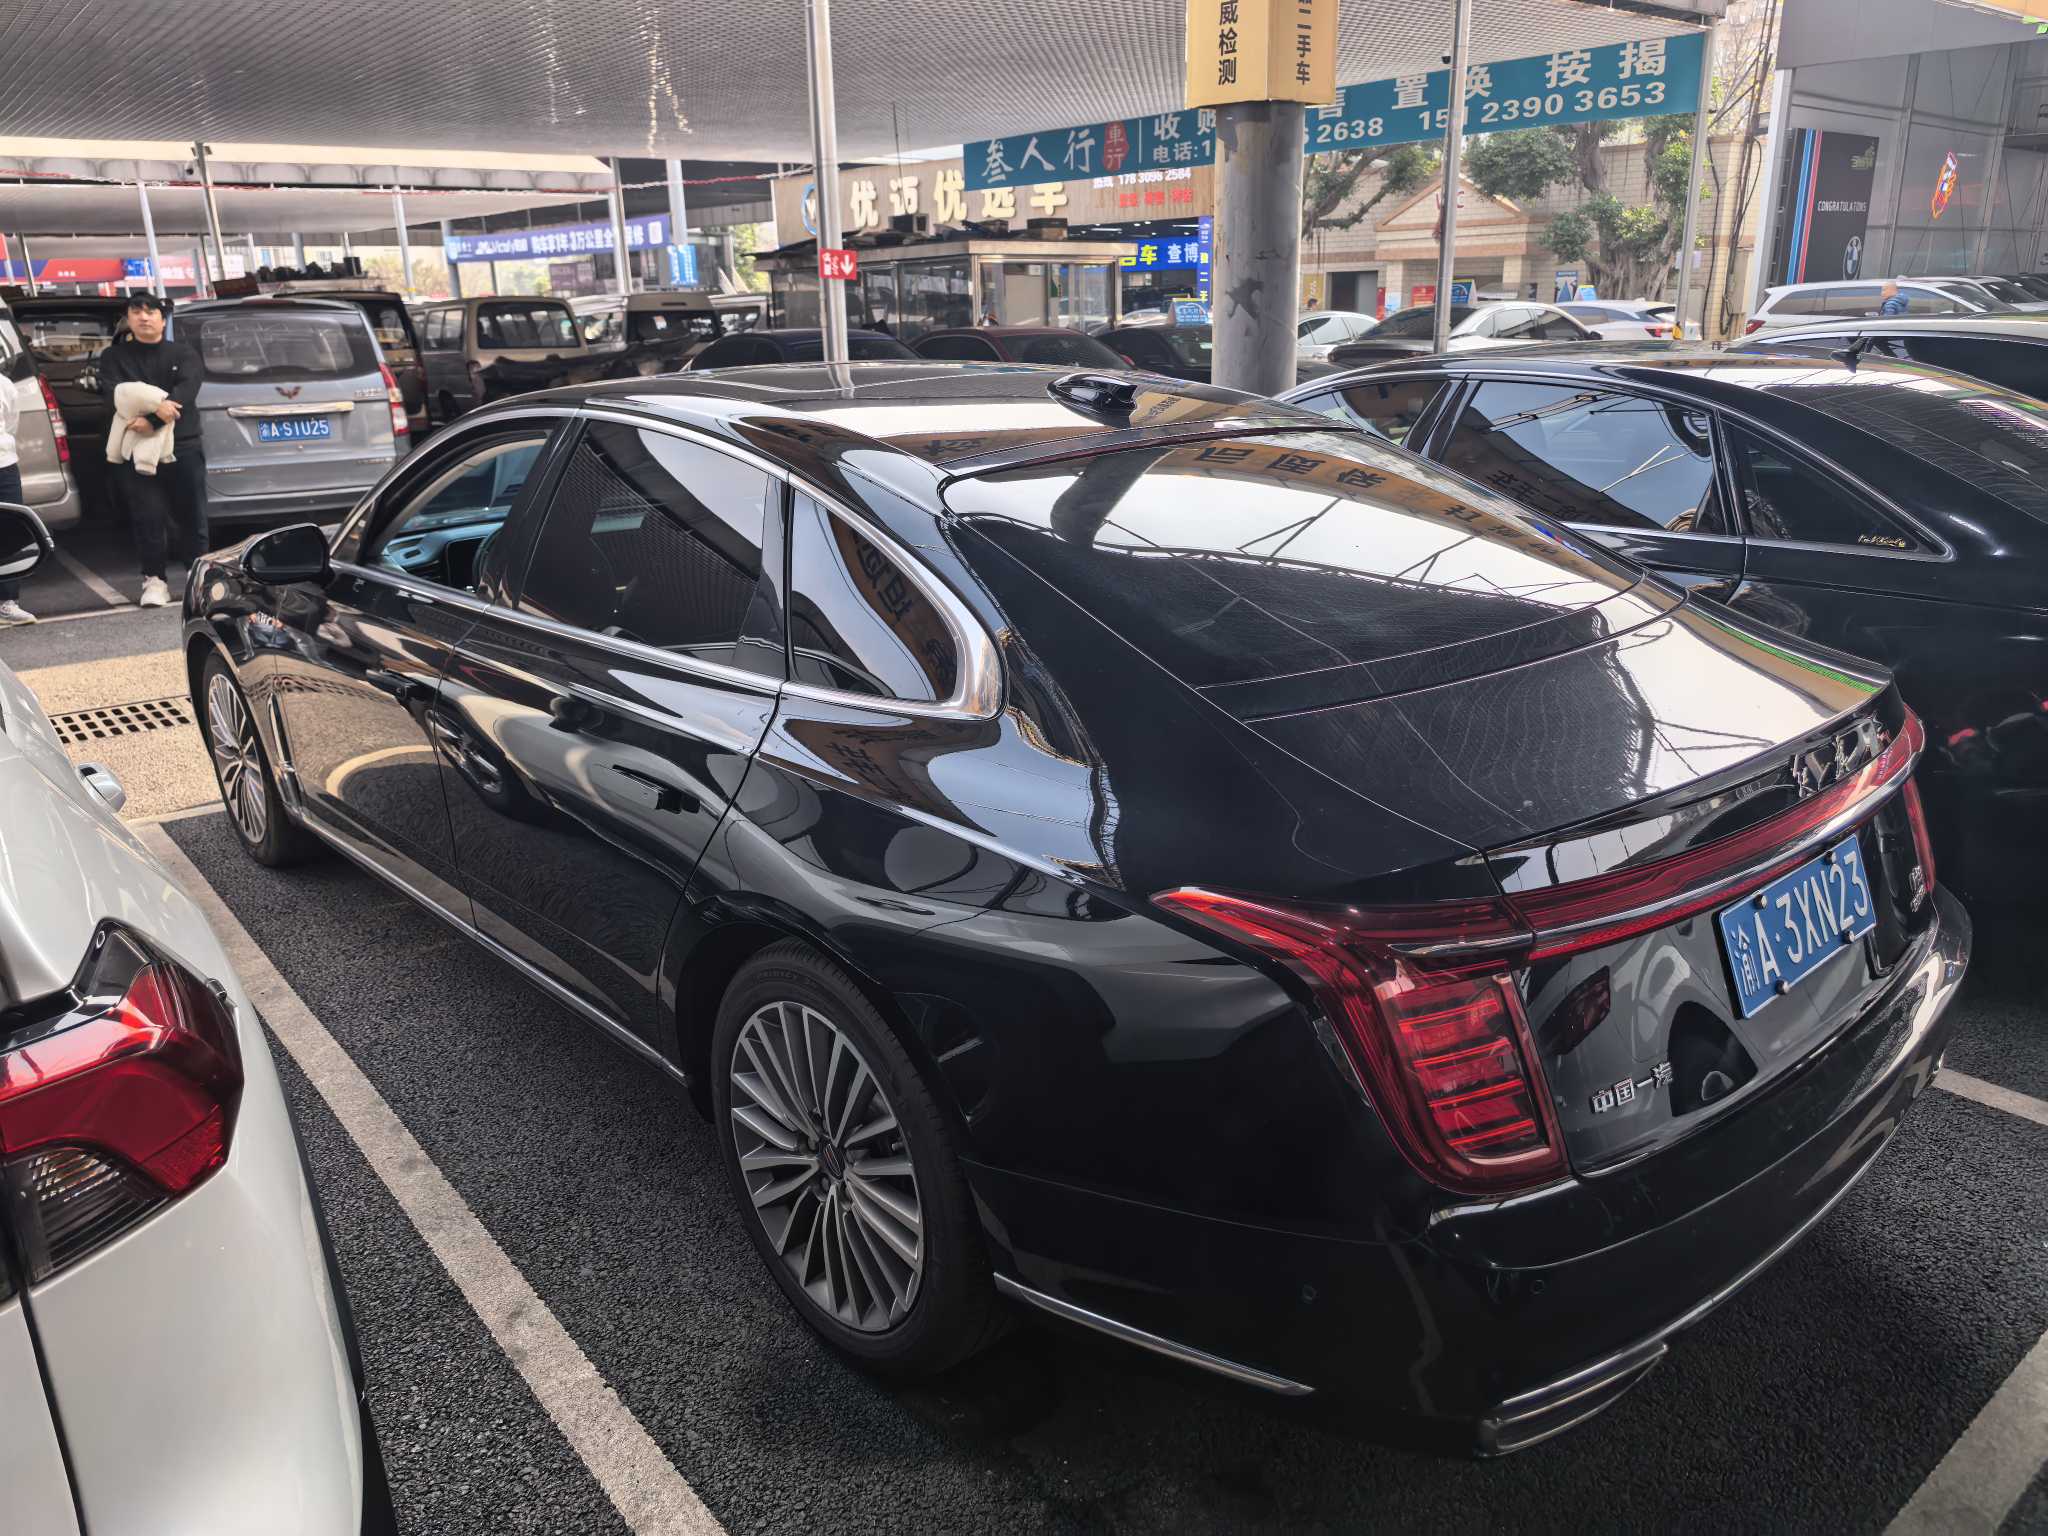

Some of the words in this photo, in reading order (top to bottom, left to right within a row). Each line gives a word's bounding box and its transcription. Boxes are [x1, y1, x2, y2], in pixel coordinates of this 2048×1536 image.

[1296, 0, 1312, 85] 二手车
[1545, 39, 1666, 88] 按揭
[1316, 117, 1384, 144] 2638
[1481, 94, 1564, 123] 2390
[1574, 82, 1666, 112] 3653
[1592, 1062, 1673, 1113] 中国一汽
